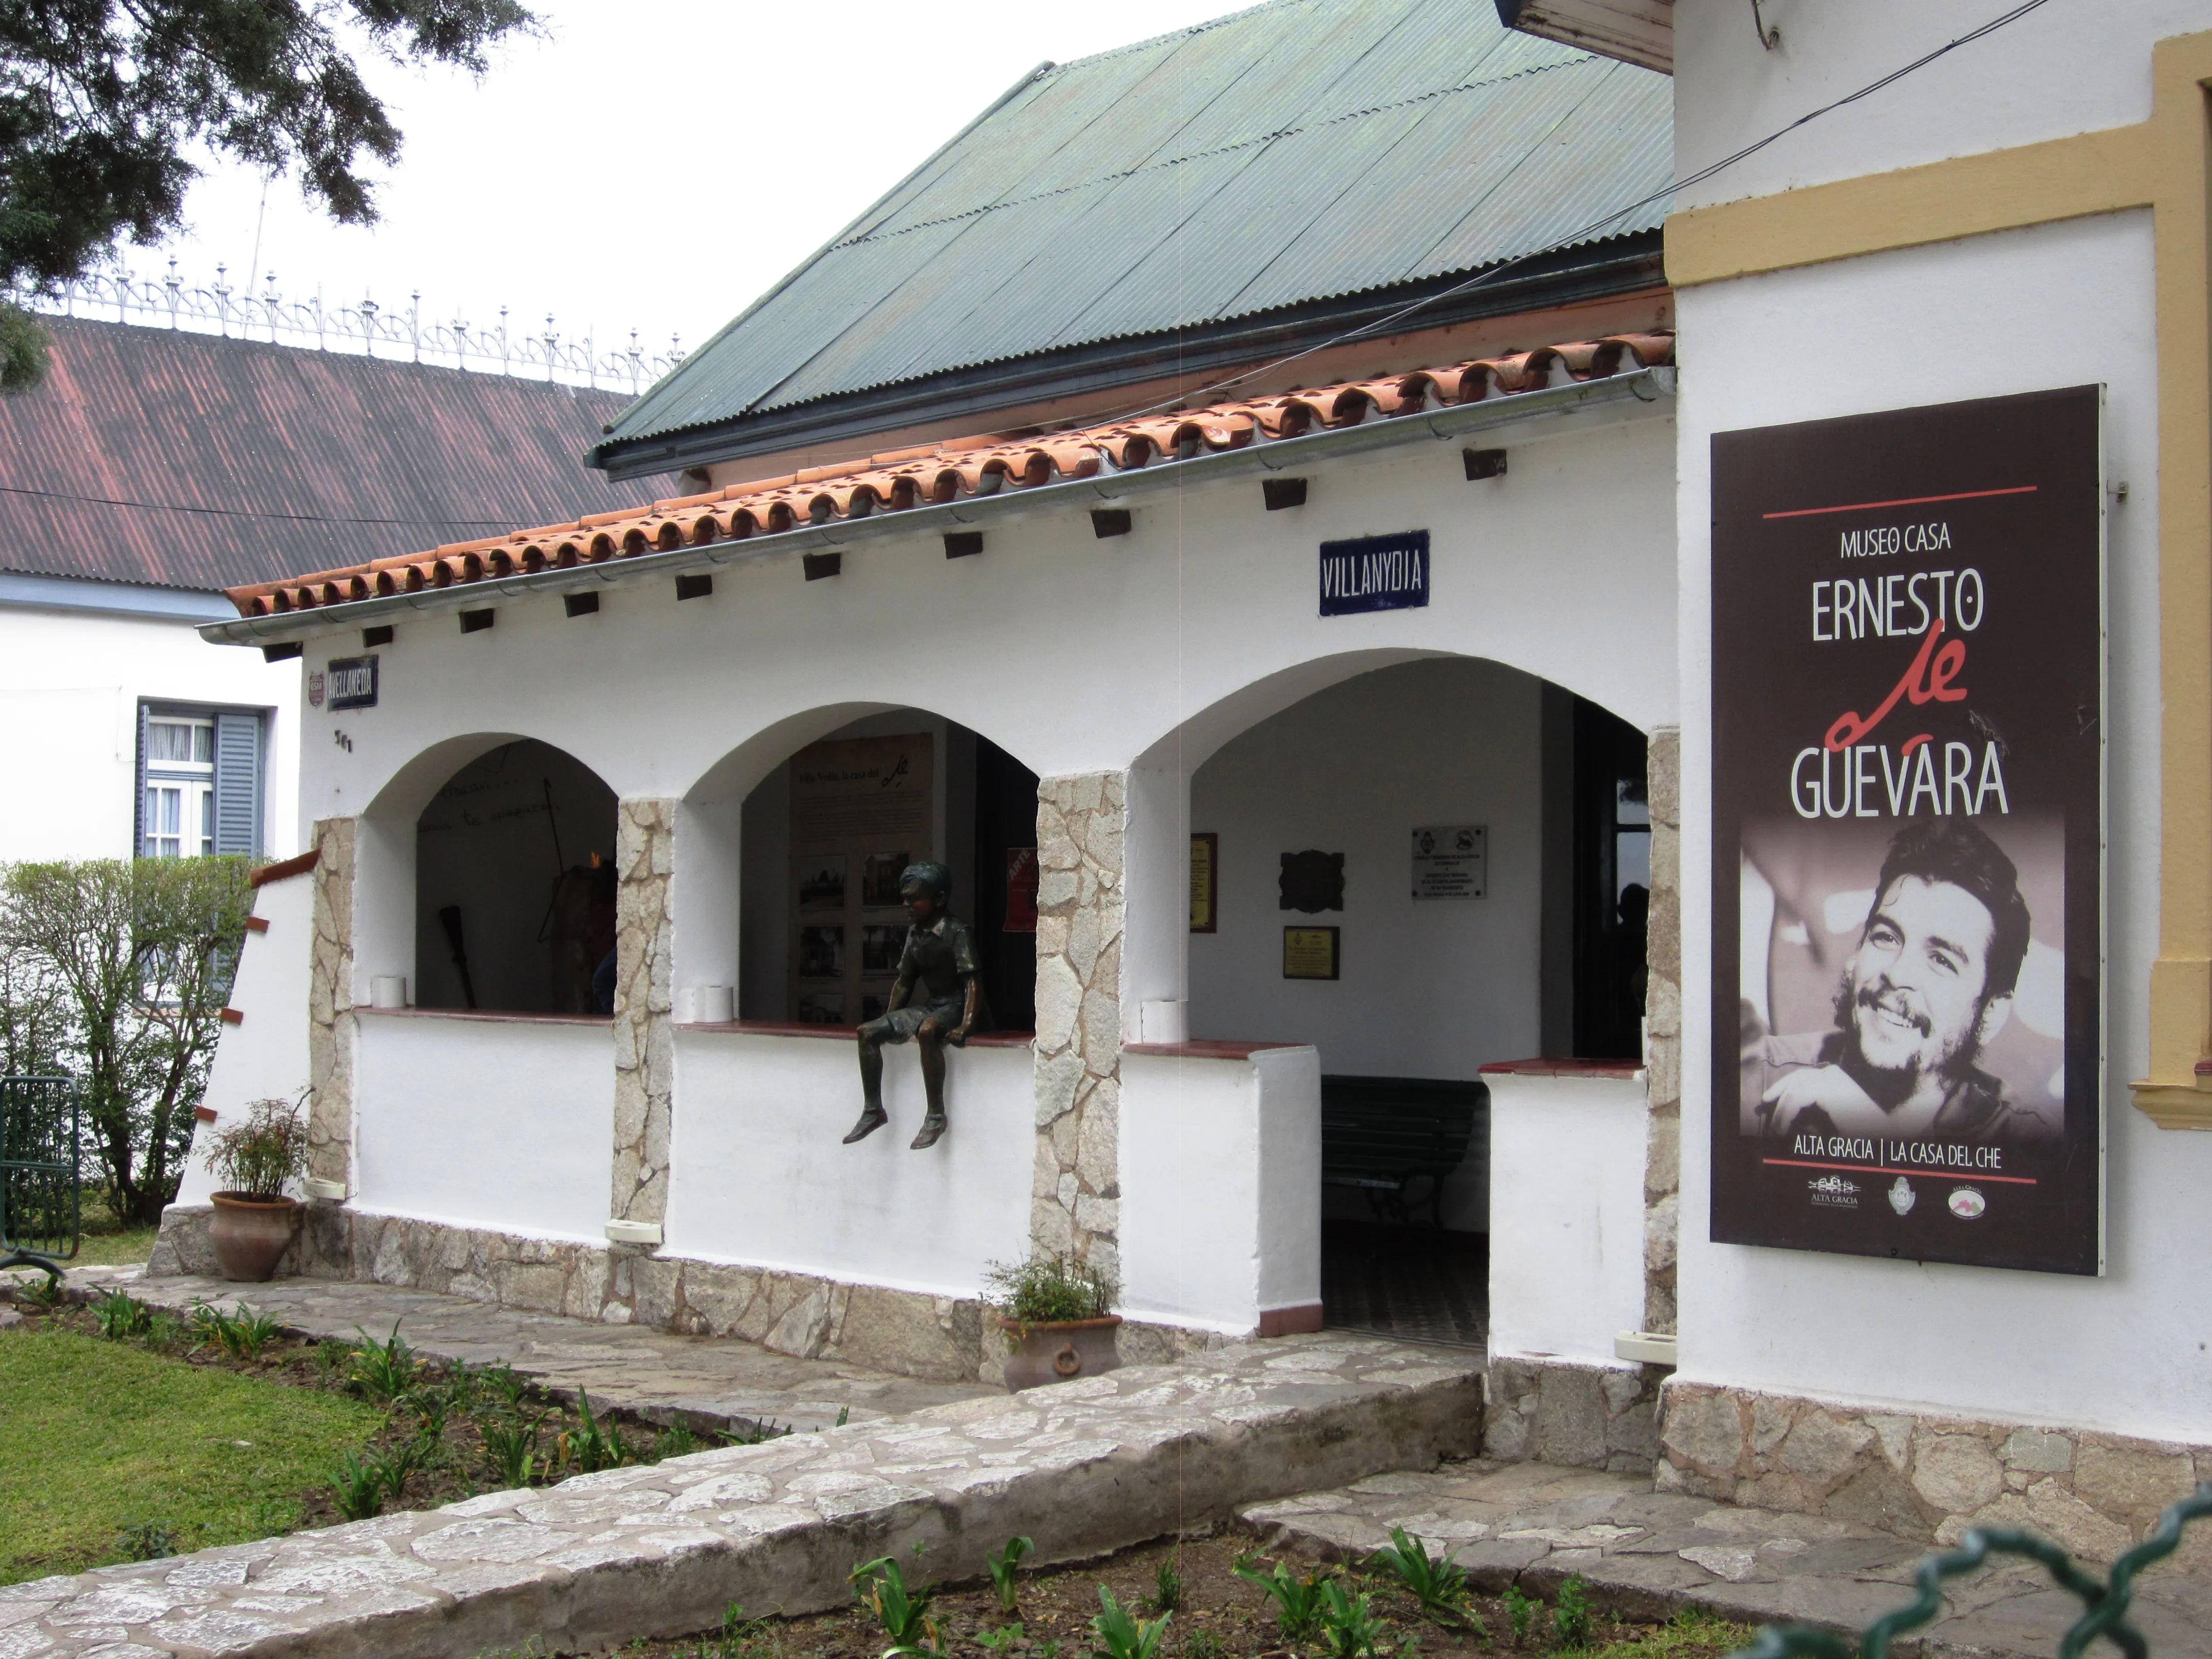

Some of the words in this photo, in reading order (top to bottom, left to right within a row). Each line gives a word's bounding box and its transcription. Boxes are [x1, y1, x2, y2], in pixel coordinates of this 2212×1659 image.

[1841, 527, 1900, 558] MUSEO
[1904, 522, 1951, 551] CASA
[1323, 549, 1421, 598] VILLANYDIA
[1813, 568, 1984, 641] ERNESTO
[328, 668, 372, 699] AVELLANEDA
[1794, 1135, 1824, 1156] ALTA
[1828, 1136, 1874, 1160] GRACIA
[1890, 1142, 1906, 1162] LA
[1910, 1142, 1944, 1164] CASA
[1948, 1145, 1972, 1166] DEL
[1975, 1147, 2002, 1168] CHE
[1812, 1194, 1831, 1202] ALTA
[1832, 1196, 1858, 1205] GRACIA
